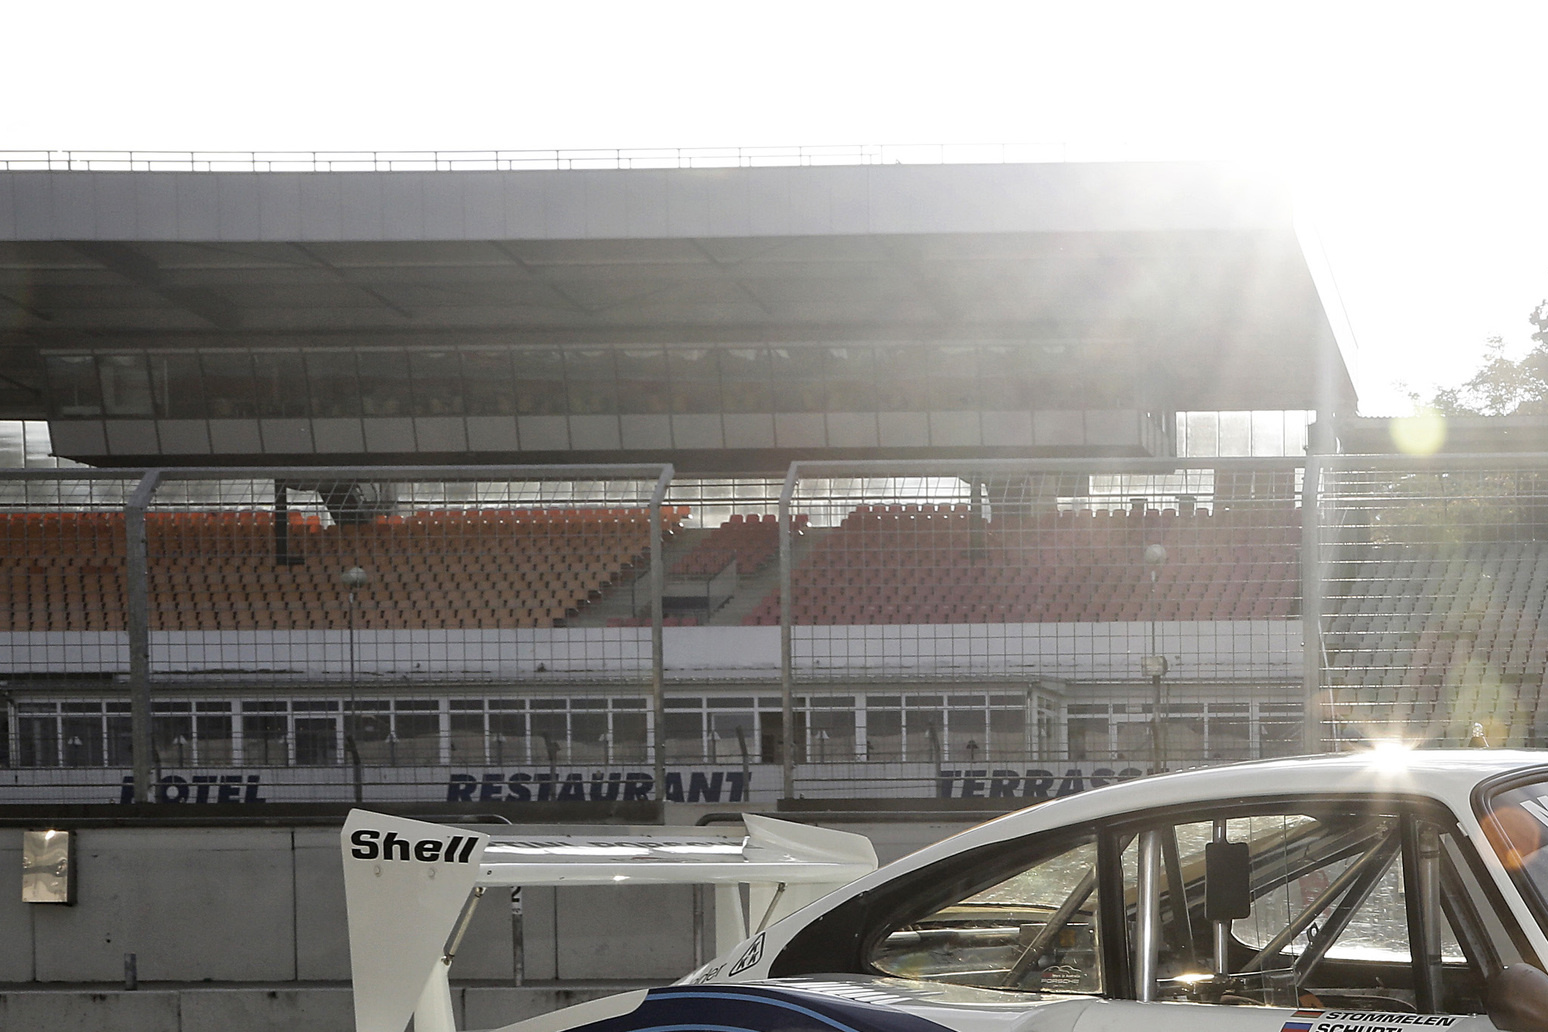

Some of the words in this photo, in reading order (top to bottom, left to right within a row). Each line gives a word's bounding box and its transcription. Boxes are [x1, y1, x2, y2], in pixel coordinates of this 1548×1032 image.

[446, 771, 752, 803] RESTAURANT
[351, 830, 479, 864] Shell
[1325, 1011, 1457, 1027] STOMMELEN
